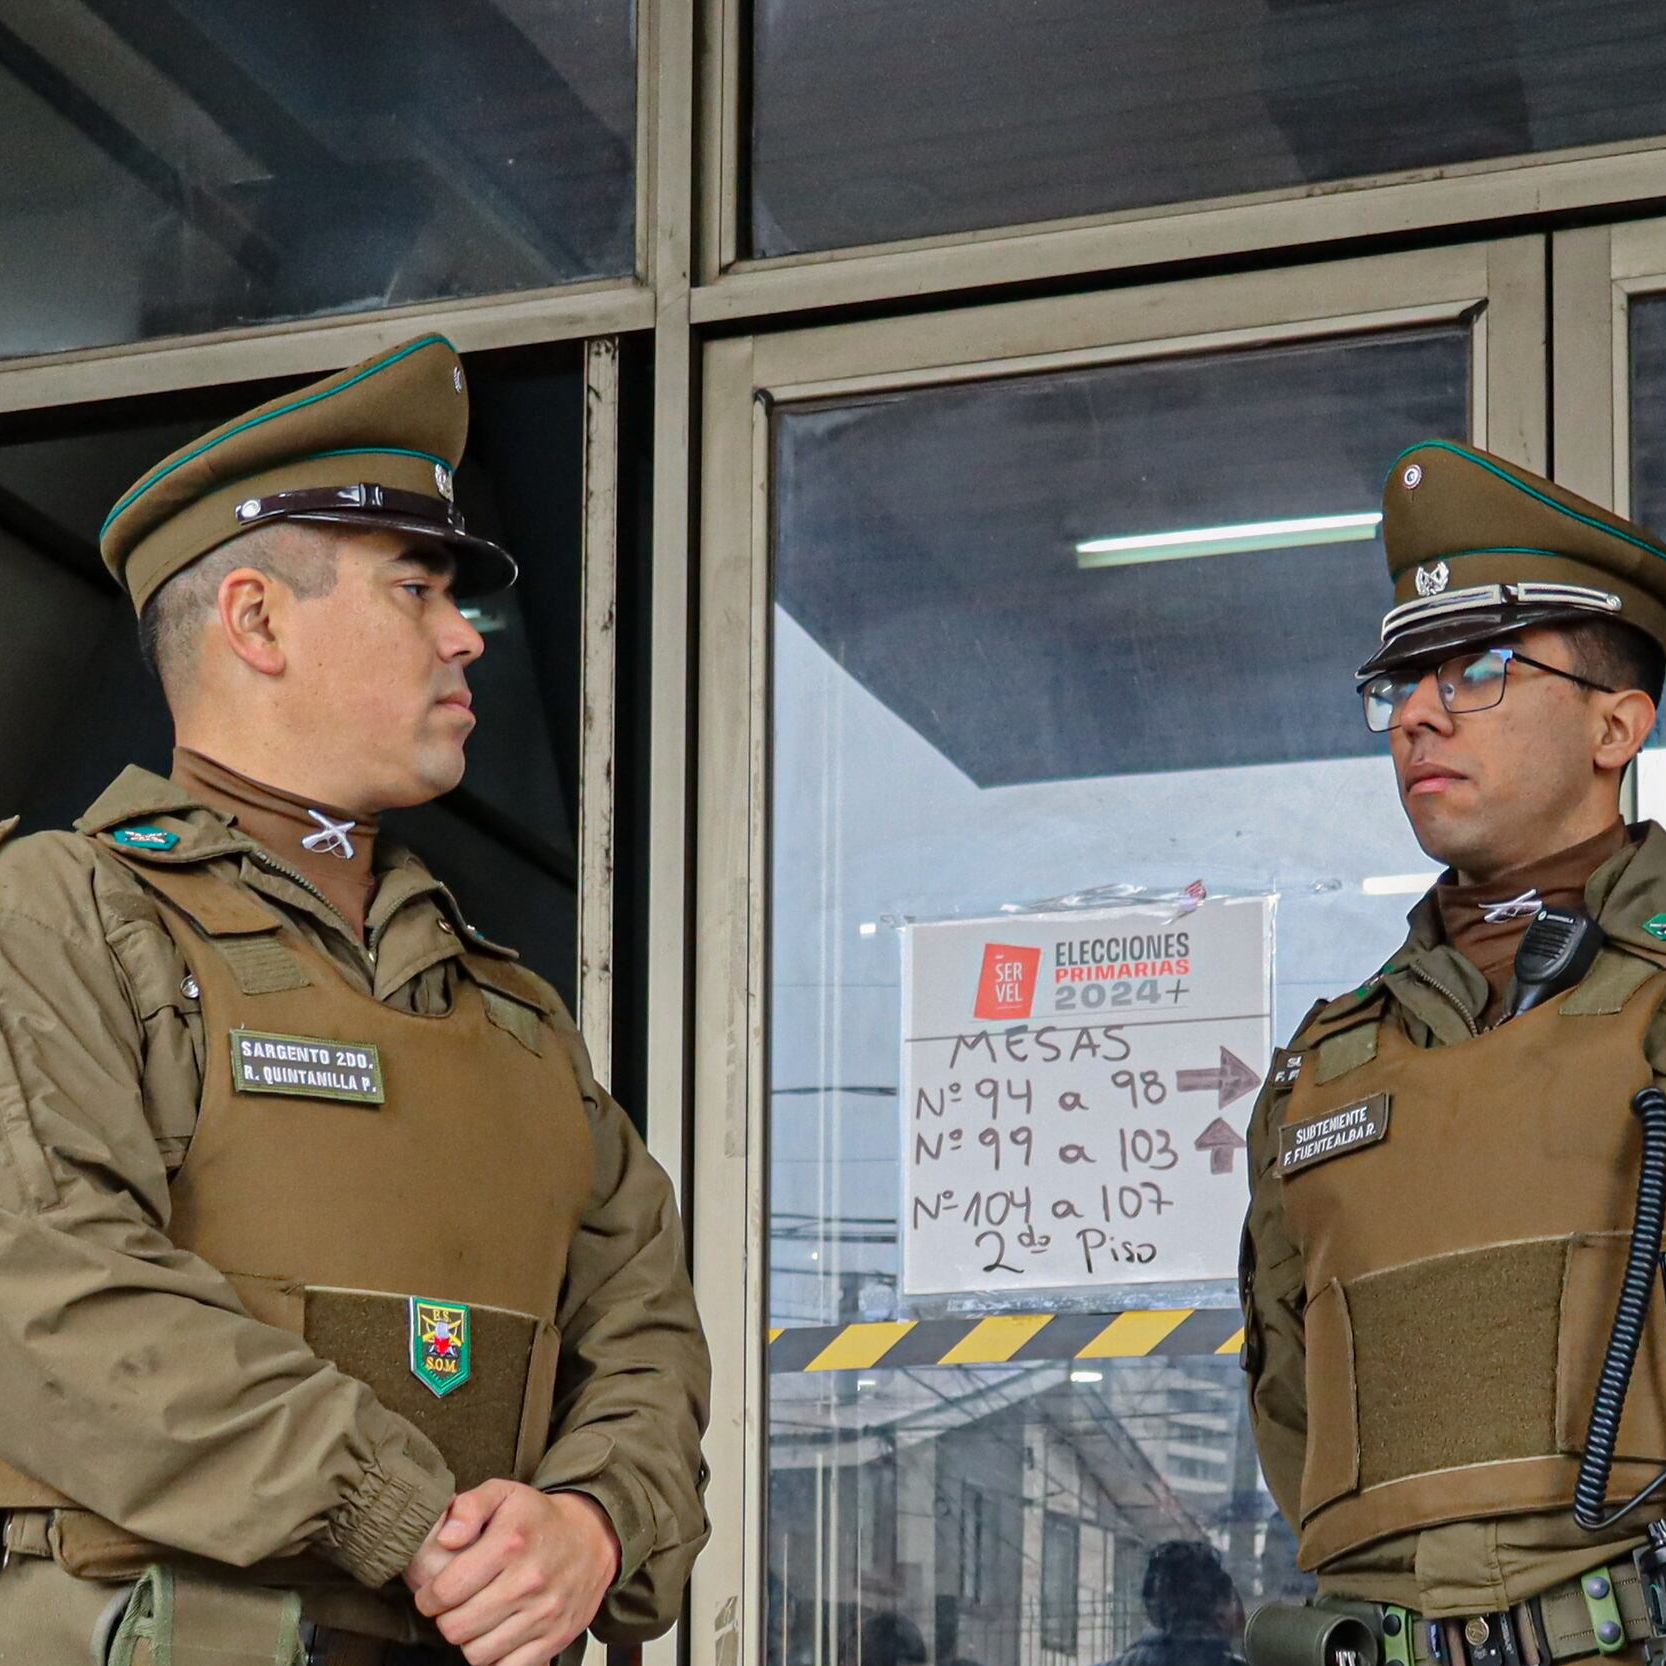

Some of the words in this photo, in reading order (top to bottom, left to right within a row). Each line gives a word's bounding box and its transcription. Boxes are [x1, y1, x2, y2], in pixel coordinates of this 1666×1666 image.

[1055, 932, 1189, 967] ELECCIONES
[995, 962, 1022, 982] SER
[1055, 959, 1189, 983] PRIMARIAS
[995, 983, 1022, 1003] VEL
[241, 1041, 330, 1065] SARGENTO
[336, 1051, 374, 1070] 2DO.
[949, 1025, 1131, 1069] MESAS
[243, 1064, 259, 1080] R.
[263, 1066, 358, 1090] QUINTANILLA
[361, 1077, 376, 1092] P.
[975, 1078, 1032, 1120] 94
[1058, 1091, 1089, 1111] a
[1110, 1069, 1167, 1109] 98
[1284, 1150, 1293, 1166] F.
[1293, 1126, 1364, 1163] FUENTEALBA
[1365, 1122, 1376, 1137] R.
[1296, 1106, 1367, 1144] SUBTENIENTE
[978, 1126, 1032, 1171] 99
[1058, 1144, 1096, 1164] a
[1119, 1128, 1179, 1172] 103
[963, 1186, 1032, 1227] 104
[1051, 1199, 1085, 1219] a
[1102, 1181, 1174, 1223] 107
[1076, 1228, 1157, 1273] Piso
